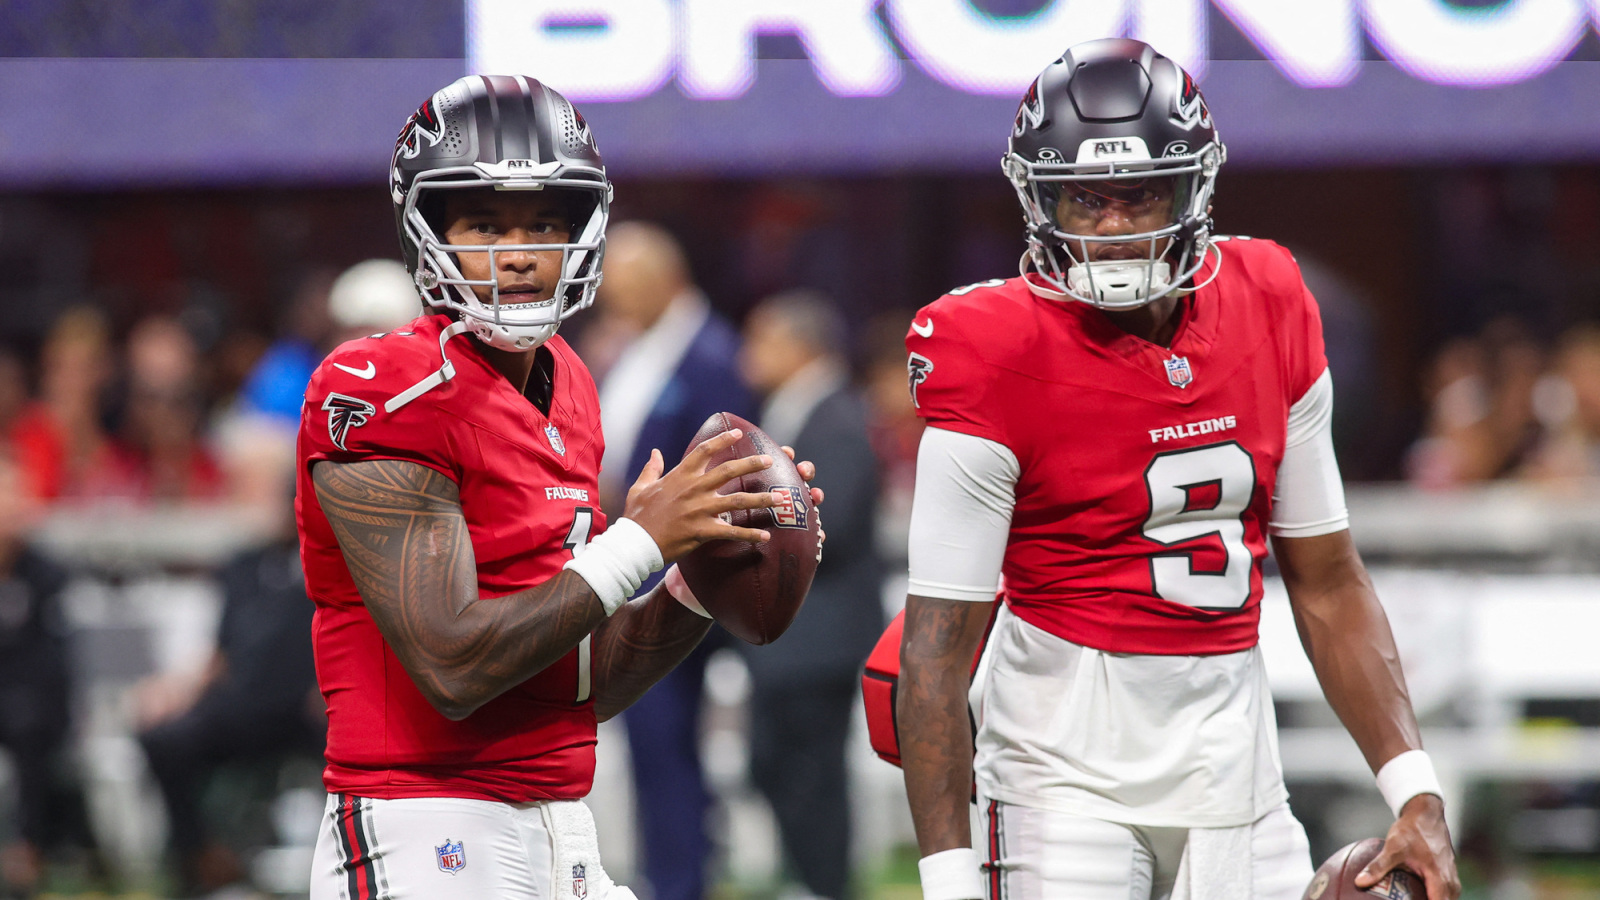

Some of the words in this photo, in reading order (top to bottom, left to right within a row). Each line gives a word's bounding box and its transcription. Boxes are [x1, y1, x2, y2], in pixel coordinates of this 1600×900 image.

[463, 0, 1600, 102] BRONC
[1094, 141, 1131, 157] ATL
[507, 160, 532, 168] ATL
[1149, 415, 1236, 443] FALCONS
[544, 487, 589, 502] FALCONS
[1140, 439, 1257, 612] 9
[441, 854, 462, 868] NFL
